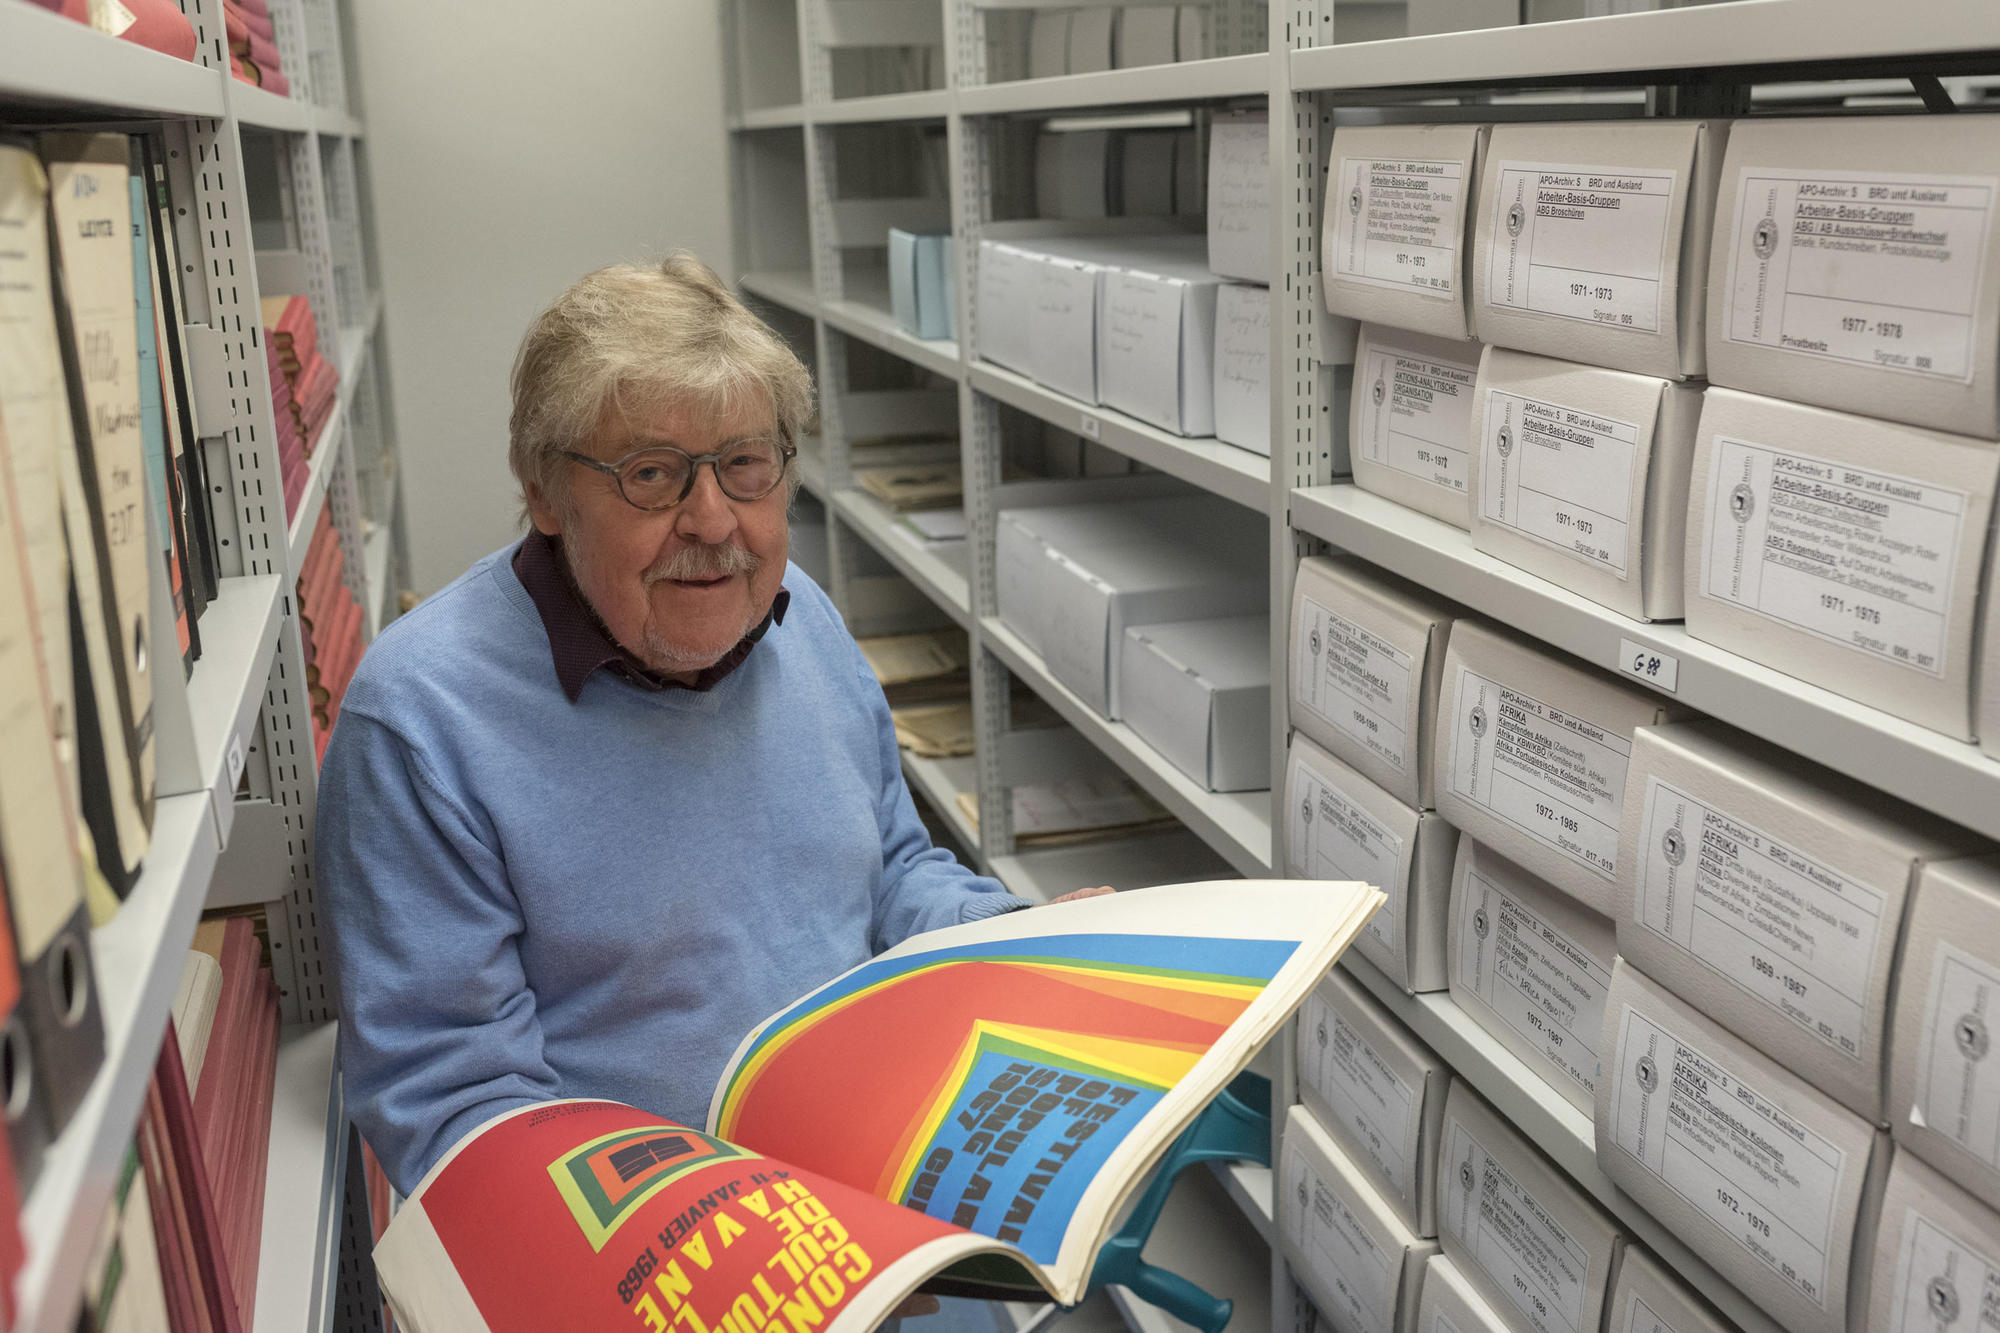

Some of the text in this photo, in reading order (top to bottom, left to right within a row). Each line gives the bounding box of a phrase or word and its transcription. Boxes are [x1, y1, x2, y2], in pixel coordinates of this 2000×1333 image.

[1371, 175, 1428, 188] Arbeiter-Basis-Gruppen
[1539, 175, 1575, 186] APO-Archiv:
[1588, 178, 1601, 188] BRD
[1603, 179, 1615, 189] und
[1616, 180, 1642, 191] Ausland
[1799, 184, 1850, 198] APO-Archiv:
[1868, 187, 1888, 200] BRD
[1890, 188, 1907, 201] und
[1909, 189, 1947, 203] Ausland
[1536, 205, 1584, 218] ABG Broschüren
[1538, 191, 1620, 207] Arbeiter-Basis-Gruppen
[1796, 203, 1914, 223] Arbeiter-Basis-Gruppen
[1396, 253, 1408, 264] 1971
[1413, 255, 1425, 267] 1973
[1569, 283, 1586, 296] 1971
[1595, 286, 1612, 300] 1973
[1592, 308, 1616, 323] Signatur
[1841, 316, 1865, 333] 1977
[1875, 321, 1903, 338] 1978
[1781, 334, 1828, 352] Privatbesitz
[1393, 383, 1433, 400] ORGANISATION
[1523, 417, 1594, 446] Arbeiter-Basis-Gruppen
[1524, 403, 1555, 419] APO-Archiv:
[1566, 413, 1578, 425] BRD
[1580, 417, 1589, 428] und
[1590, 420, 1612, 434] Ausland
[1522, 431, 1560, 450] ABG Broschüren
[1774, 457, 1825, 479] APO-Archiv:
[1843, 473, 1863, 487] BRD
[1865, 478, 1882, 492] und
[1884, 482, 1921, 501] Ausland
[1773, 475, 1889, 515] Arbeiter-Basis-Gruppen
[1556, 512, 1570, 526] 1971
[1576, 519, 1592, 534] 1973
[1575, 540, 1595, 557] Signatur
[1820, 593, 1844, 612] 1971
[1854, 604, 1881, 624] 1976
[1499, 703, 1526, 723] AFRIKA
[1501, 689, 1536, 712] APO-Archiv:
[1549, 710, 1562, 724] BRD
[1565, 717, 1576, 730] und
[1577, 722, 1603, 742] Ausland
[1498, 715, 1585, 764] Kämpfendes Afrika (Zeitschrift)
[1496, 738, 1614, 803] Afrika Portugiesische Kolonien (Gesamt)
[1497, 727, 1514, 741] Afrika
[1587, 769, 1607, 786] Afrika)
[1535, 802, 1553, 820] 1972
[1560, 815, 1578, 833] 1985
[1558, 834, 1581, 856] Signatur
[1585, 849, 1596, 862] 017
[1601, 858, 1612, 871] 019
[1703, 828, 1738, 856] AFRIKA
[1705, 812, 1752, 845] APO-Archiv:
[1769, 845, 1787, 863] BRD
[1790, 856, 1806, 873] und
[1807, 865, 1842, 892] Ausland
[1700, 857, 1720, 876] Afrika
[1500, 911, 1517, 931] Afrika
[1501, 898, 1532, 927] APO-Archiv:
[1542, 928, 1554, 944] BRD
[1556, 938, 1565, 952] und
[1565, 946, 1587, 969] Ausland
[1511, 943, 1527, 962] Azania
[1750, 954, 1774, 979] 1969
[1782, 974, 1807, 999] 1987
[1526, 1010, 1541, 1031] 1972
[1547, 1027, 1562, 1048] 1987
[1675, 1060, 1708, 1092] AFRIKA
[957, 1063, 1035, 1132] 1967
[1063, 1080, 1111, 1118] OF
[1676, 1045, 1720, 1084] APO-Archiv:
[1736, 1087, 1754, 1107] BRD
[1755, 1100, 1770, 1118] und
[1772, 1111, 1804, 1141] Ausland
[962, 1068, 1060, 1155] SONG
[1673, 1075, 1784, 1162] Afrika Portugiesische Kolonien
[657, 1179, 742, 1250] JANVIER
[766, 1199, 830, 1244] DE
[1717, 1187, 1738, 1213] 1972
[1747, 1210, 1770, 1238] 1976
[616, 1246, 660, 1305] 1968
